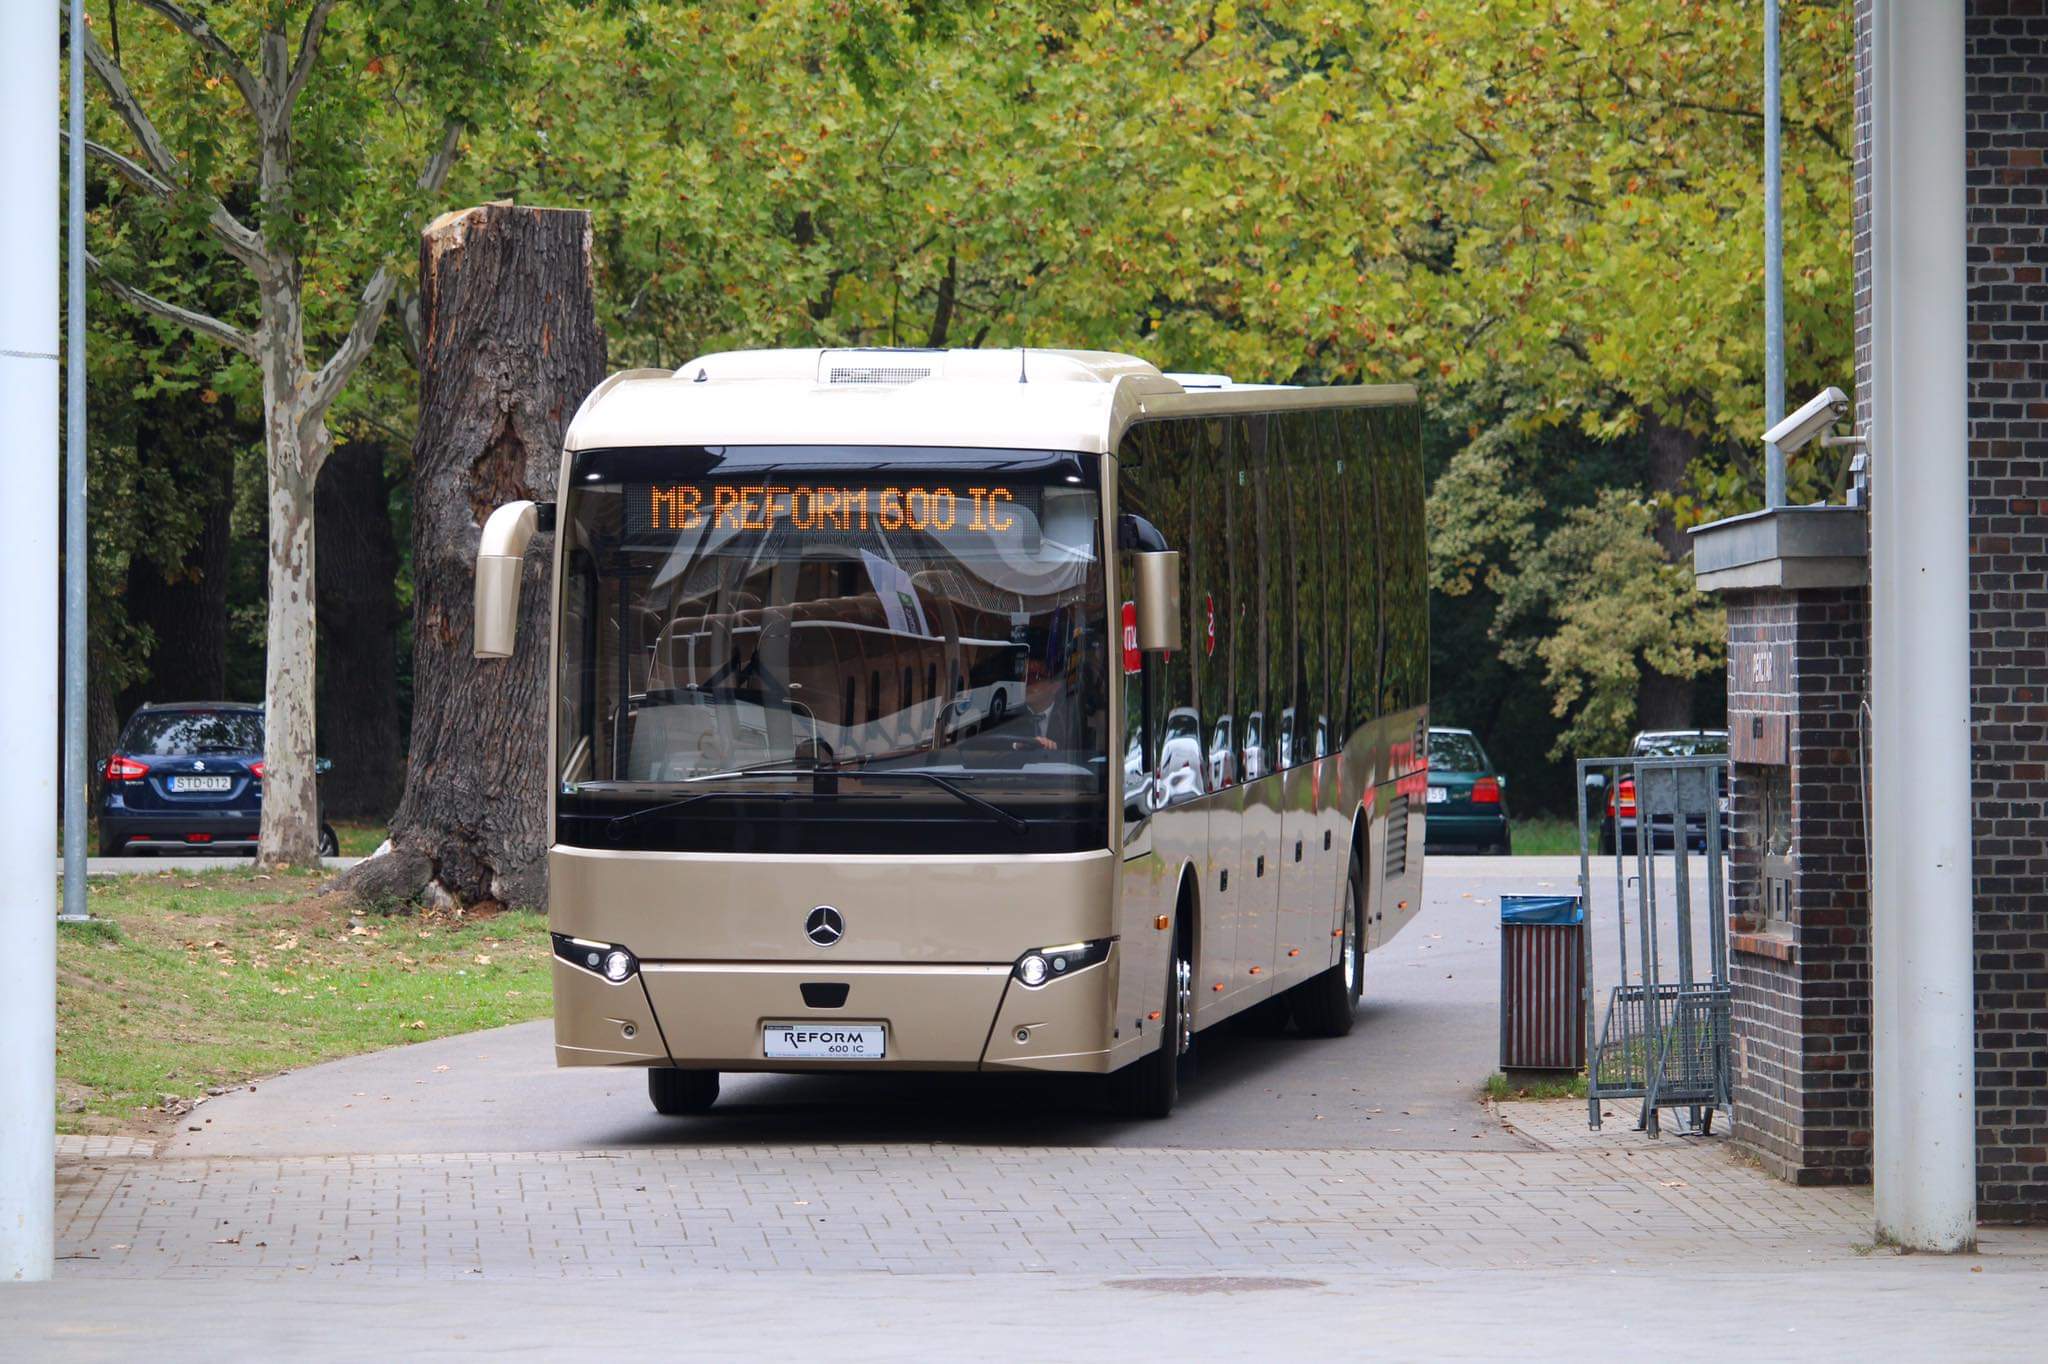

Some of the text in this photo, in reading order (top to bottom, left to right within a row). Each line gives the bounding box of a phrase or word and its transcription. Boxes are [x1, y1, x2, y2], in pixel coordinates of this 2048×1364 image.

[651, 485, 1013, 531] MB REFORM 600 IC
[176, 776, 228, 788] STD-012
[784, 1032, 864, 1048] REFORM
[828, 1045, 864, 1053] 600 IC
